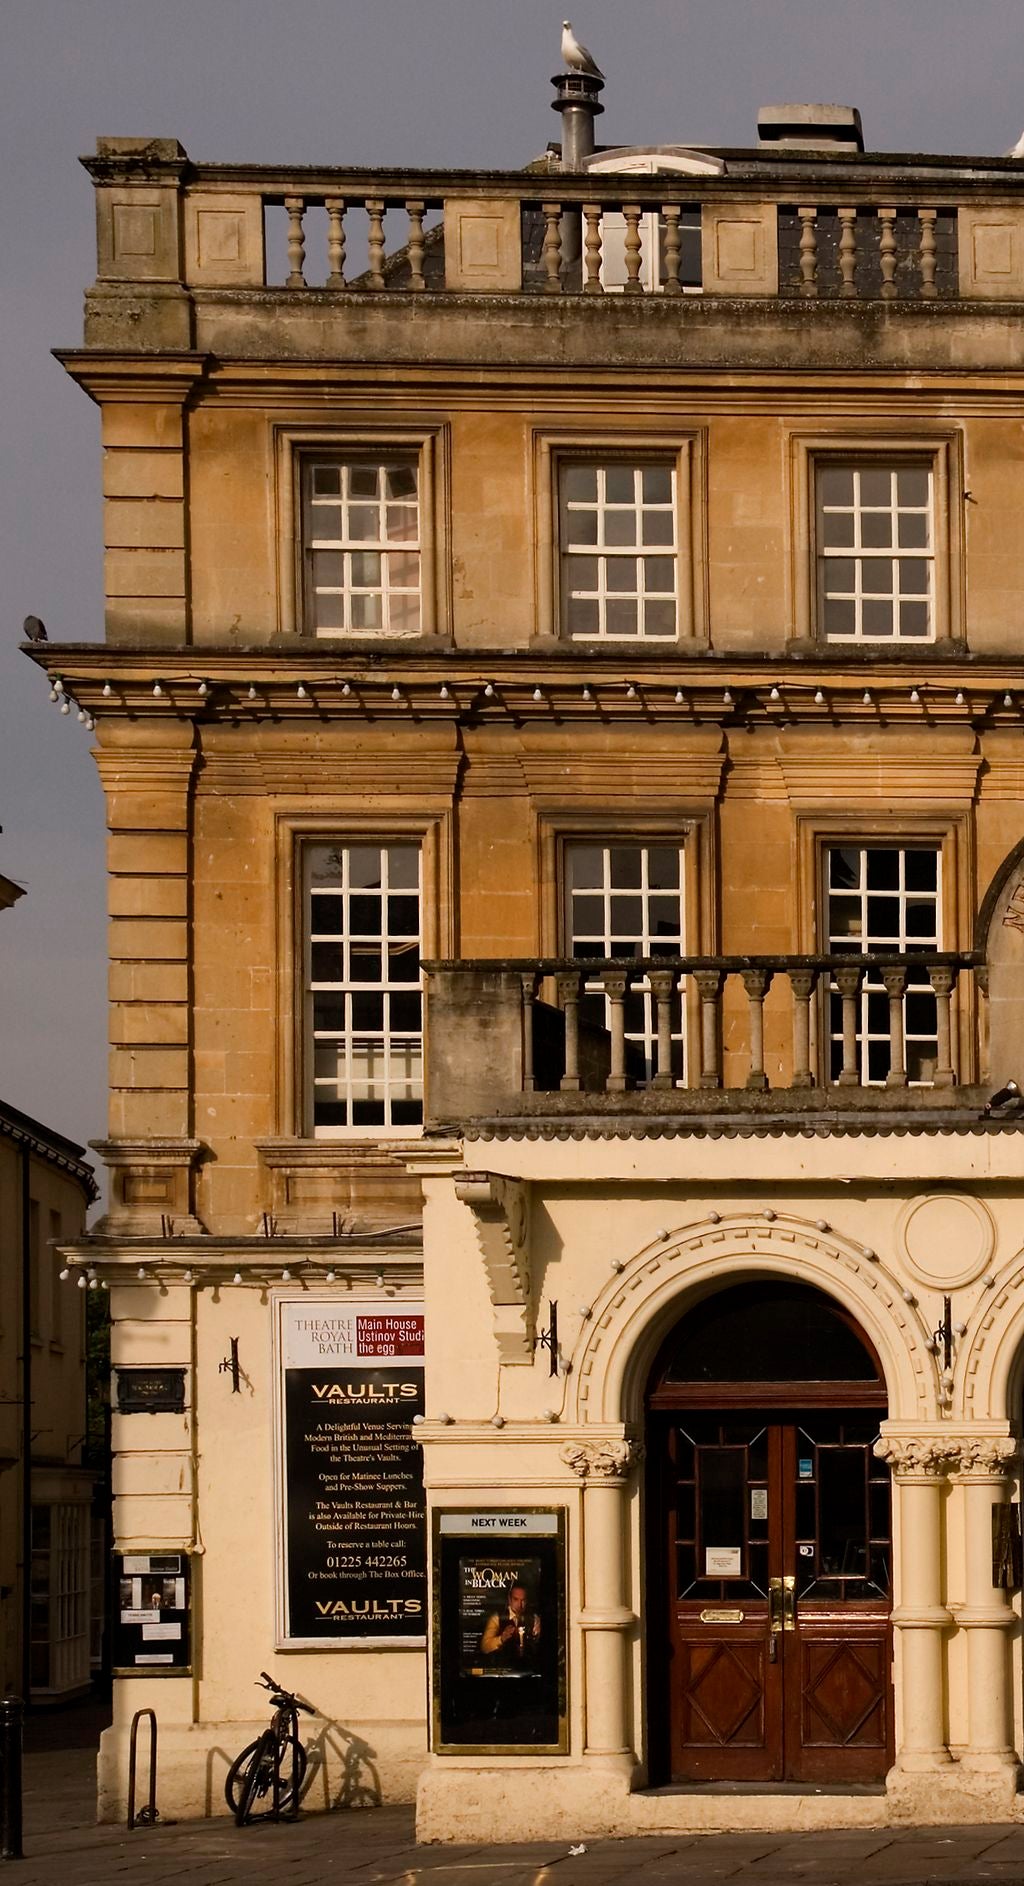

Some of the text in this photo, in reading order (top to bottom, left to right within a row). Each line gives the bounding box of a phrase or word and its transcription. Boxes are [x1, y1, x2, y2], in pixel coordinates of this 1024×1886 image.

[295, 1320, 352, 1330] THEATRE
[358, 1319, 417, 1329] Main House
[312, 1332, 353, 1342] ROYAL
[358, 1331, 424, 1341] Ustinov Studi
[319, 1343, 353, 1354] BATH
[359, 1343, 395, 1355] the egg
[311, 1384, 418, 1397] VAULTS
[324, 1423, 360, 1432] Delightful
[384, 1444, 409, 1452] Setting
[318, 1473, 338, 1482] Open
[325, 1483, 338, 1491] and
[376, 1483, 407, 1491] Suppers.
[471, 1518, 528, 1527] NEXT WEEK
[326, 1556, 407, 1567] 01225 442265
[340, 1571, 367, 1580] through
[384, 1570, 399, 1578] Box
[401, 1570, 426, 1578] Office.
[472, 1568, 518, 1582] WOMAN
[472, 1579, 506, 1588] BLACK
[315, 1599, 422, 1614] VAULTS
